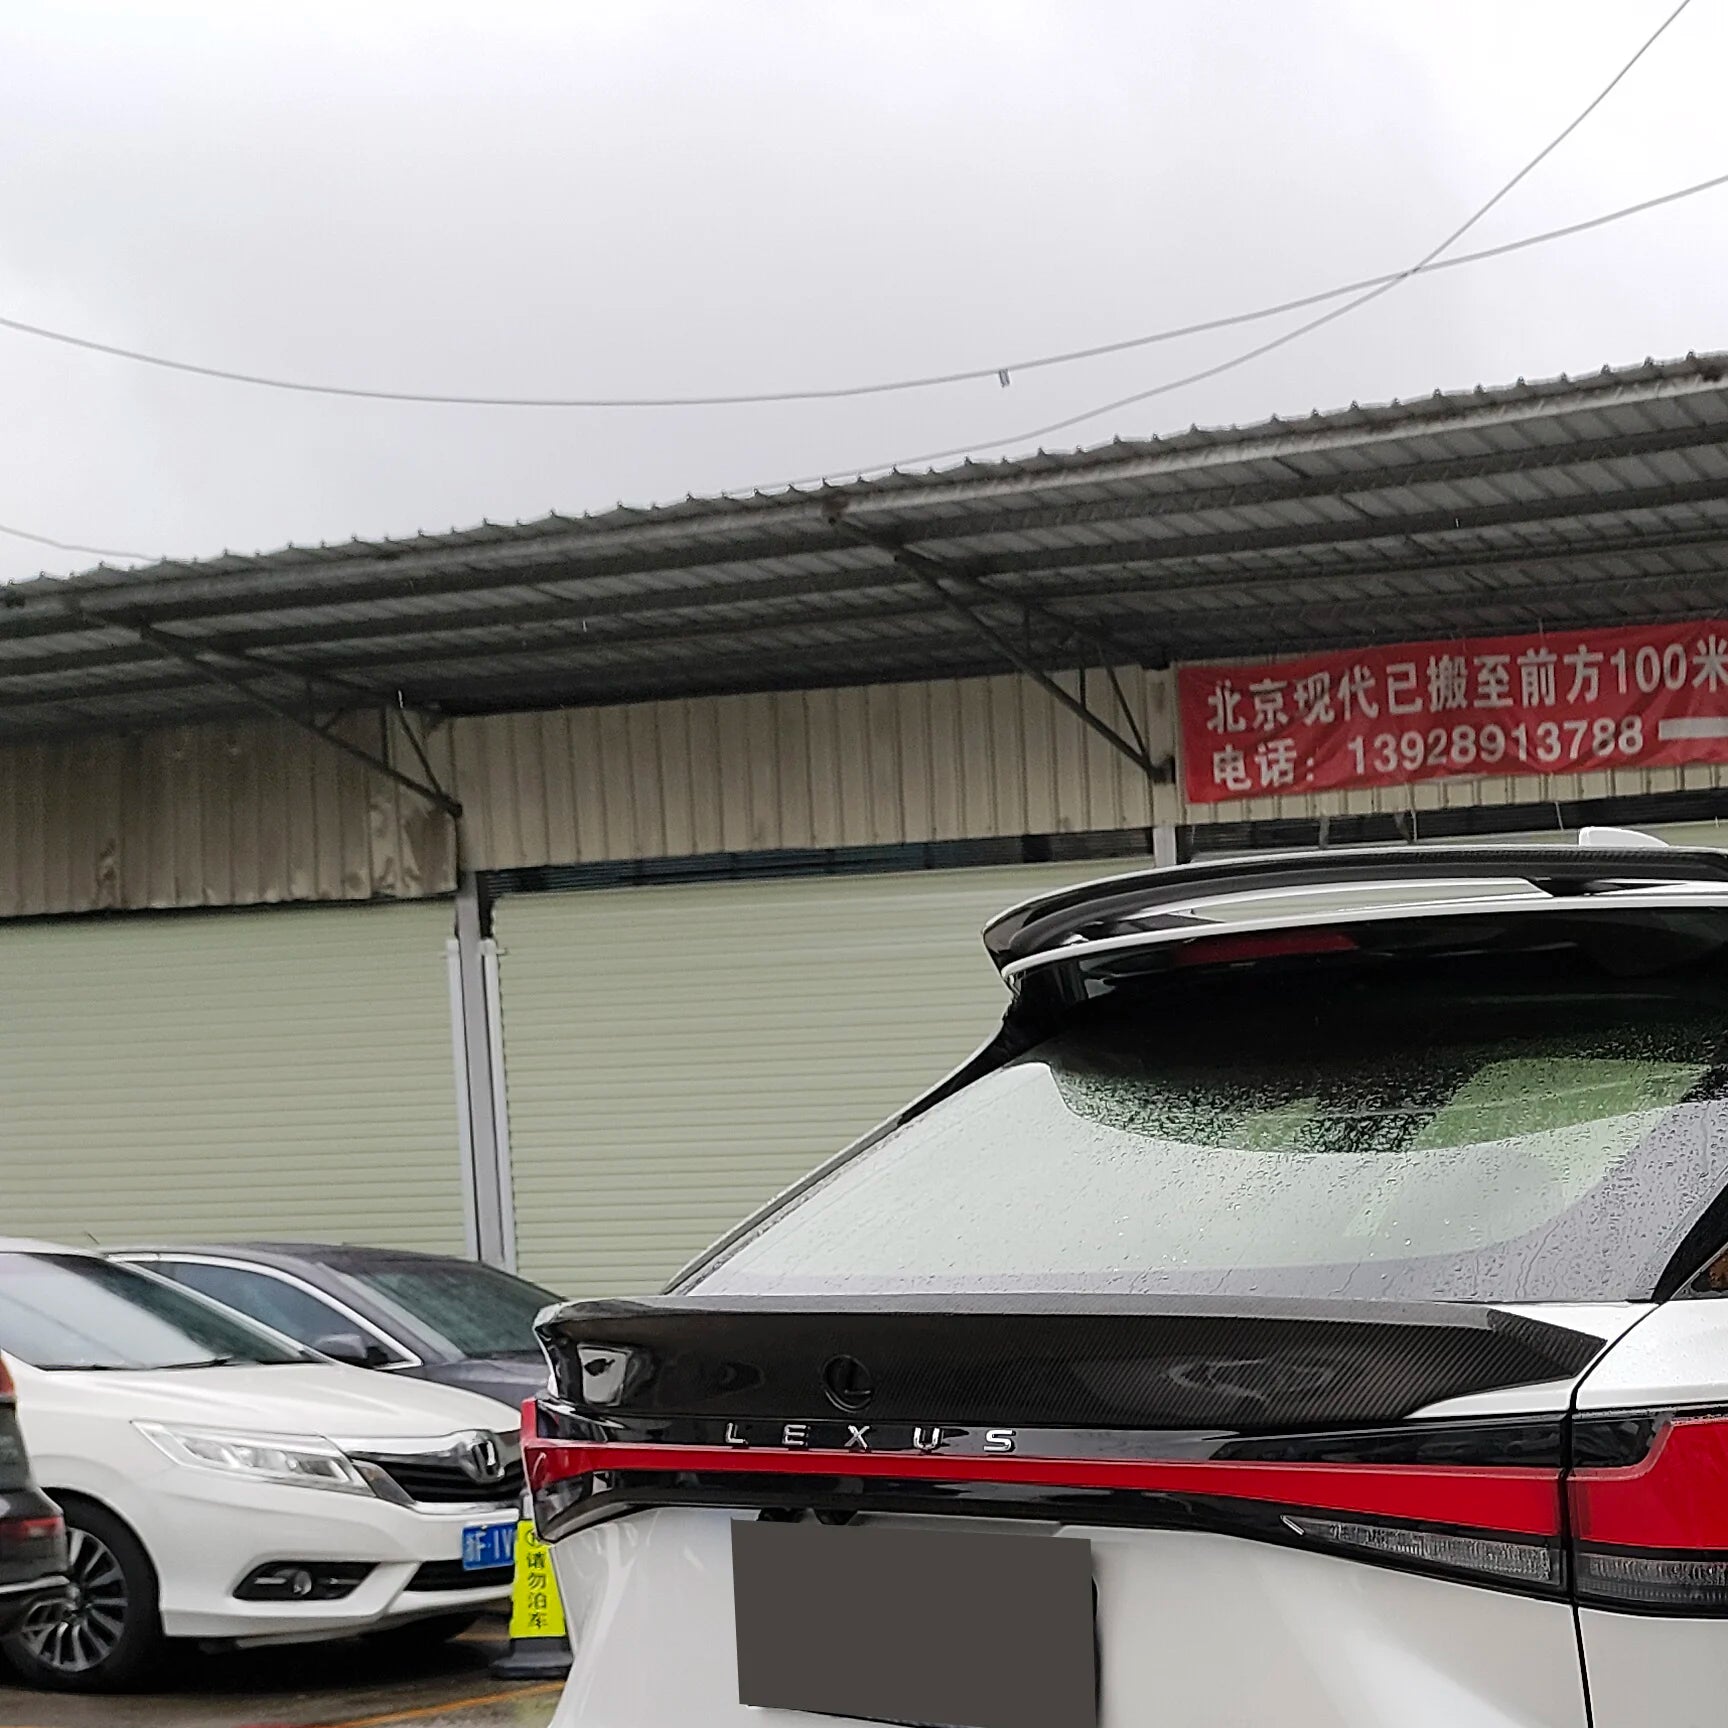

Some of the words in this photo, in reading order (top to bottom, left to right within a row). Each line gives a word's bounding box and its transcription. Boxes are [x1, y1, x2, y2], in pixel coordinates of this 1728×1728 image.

[1348, 715, 1644, 775] 13928913788
[725, 1422, 1018, 1452] LEXUS
[526, 1551, 549, 1630] 请勿泊车
